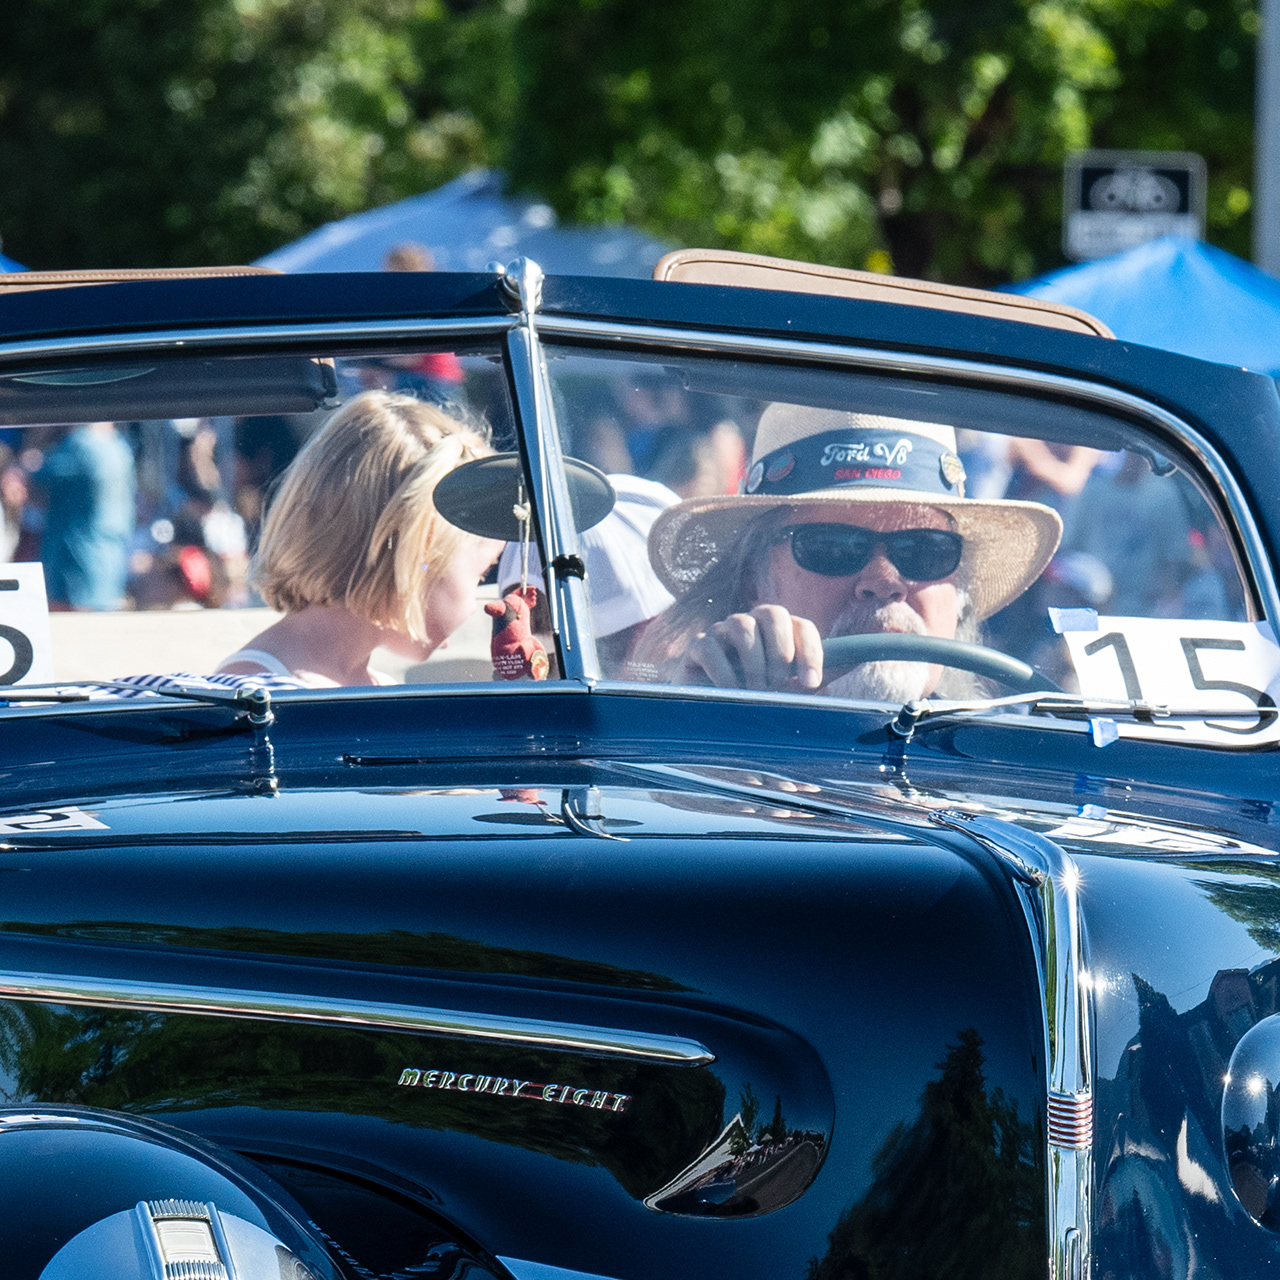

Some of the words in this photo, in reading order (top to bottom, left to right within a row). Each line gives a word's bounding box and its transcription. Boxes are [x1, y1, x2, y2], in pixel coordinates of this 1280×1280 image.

[821, 443, 870, 466] Ford
[873, 438, 913, 466] V8
[834, 469, 861, 480] SAN
[864, 468, 902, 480] DIEGO
[1084, 632, 1279, 735] 15
[398, 1068, 529, 1097] MERCURY
[542, 1084, 631, 1112] EIGHT
